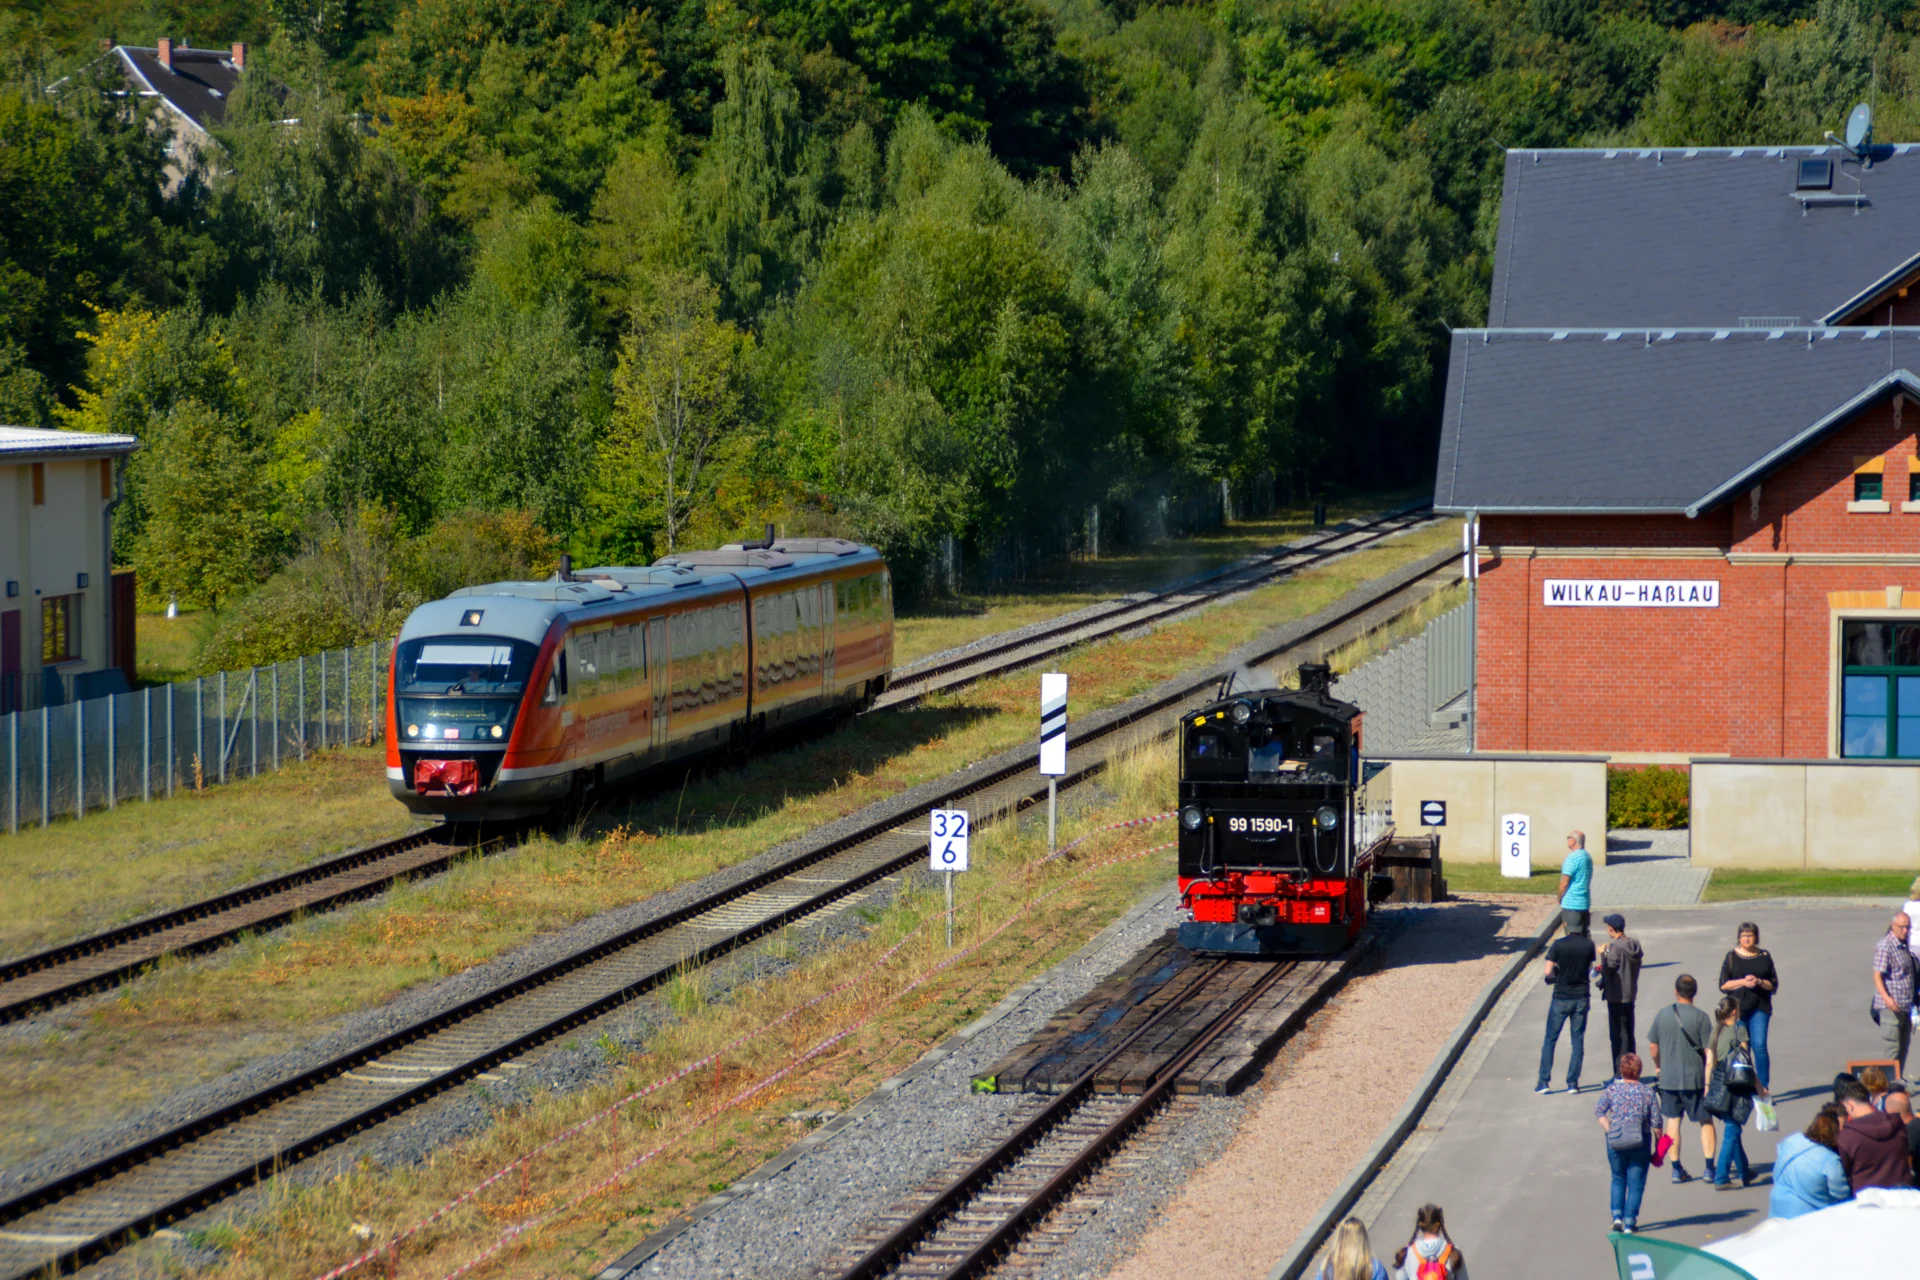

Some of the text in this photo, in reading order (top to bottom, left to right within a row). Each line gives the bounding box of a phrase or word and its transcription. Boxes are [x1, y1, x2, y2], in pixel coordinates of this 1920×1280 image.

[934, 814, 965, 837] 32
[1229, 817, 1293, 832] 99 1590-1
[1506, 820, 1527, 836] 32
[942, 840, 956, 864] 6
[1511, 842, 1520, 857] 6
